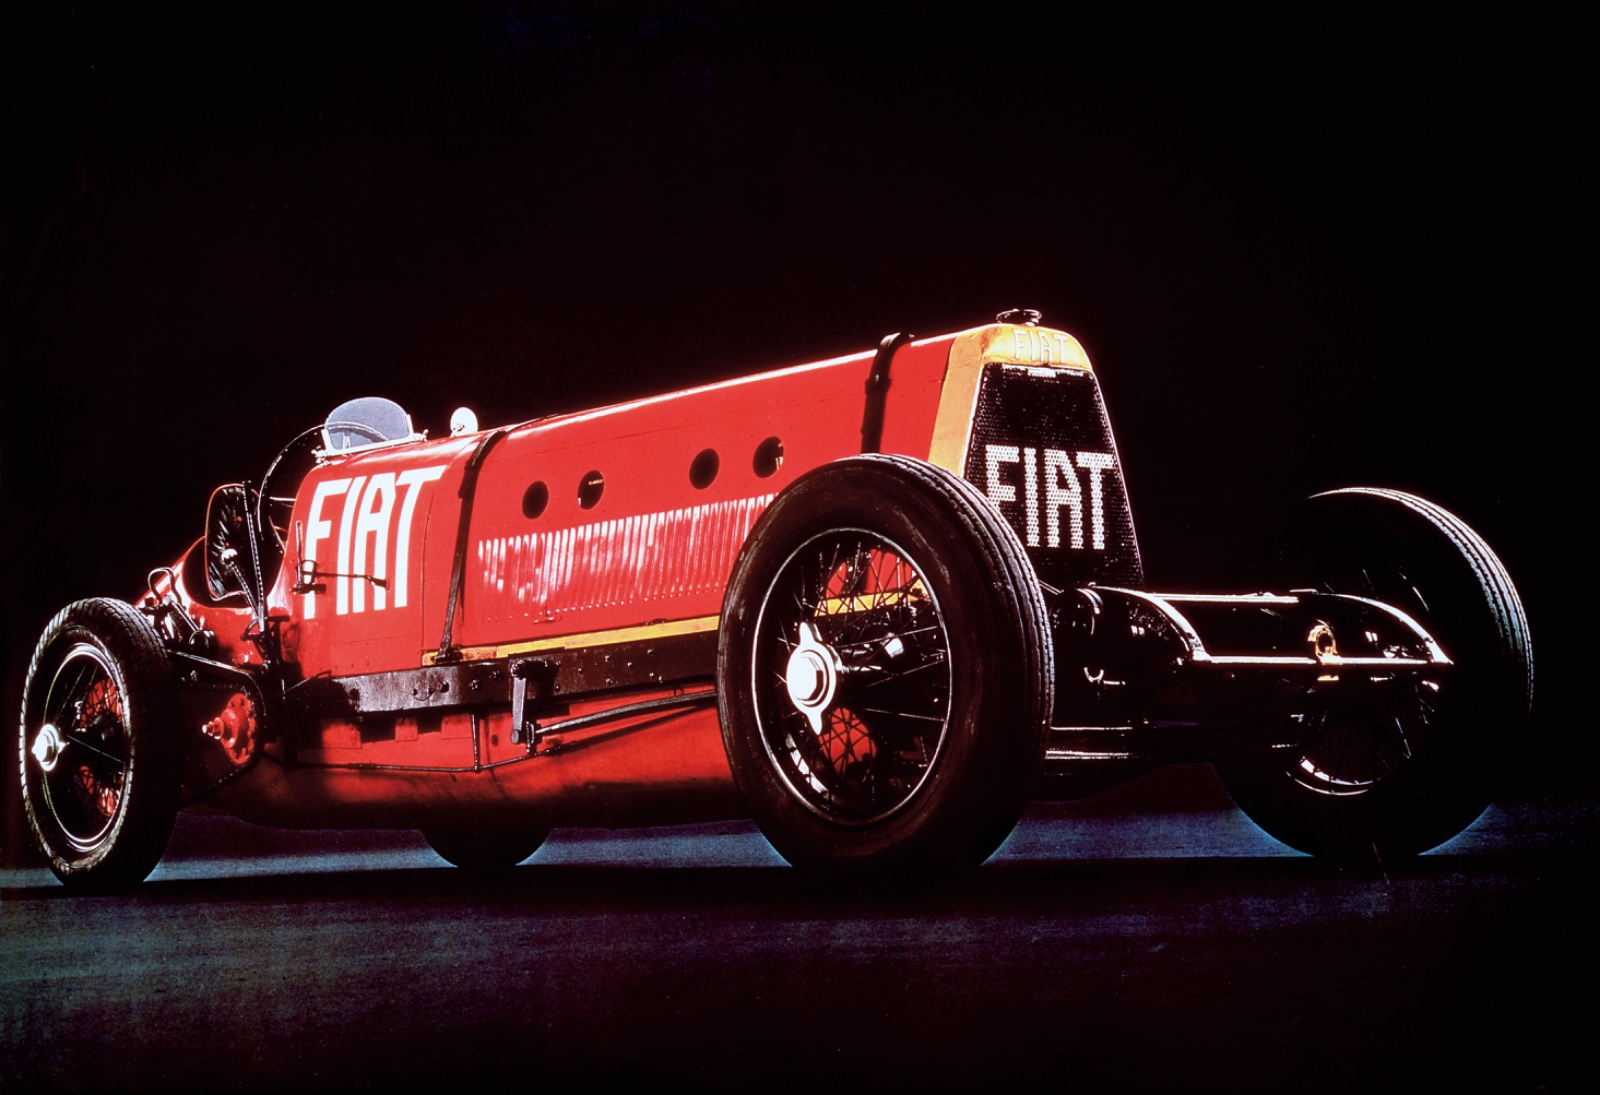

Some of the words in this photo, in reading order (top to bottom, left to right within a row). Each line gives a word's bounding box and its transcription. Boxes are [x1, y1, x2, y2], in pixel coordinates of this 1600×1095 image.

[1013, 328, 1068, 363] FIAT
[303, 464, 448, 620] FIAT
[985, 444, 1114, 550] FIAT
